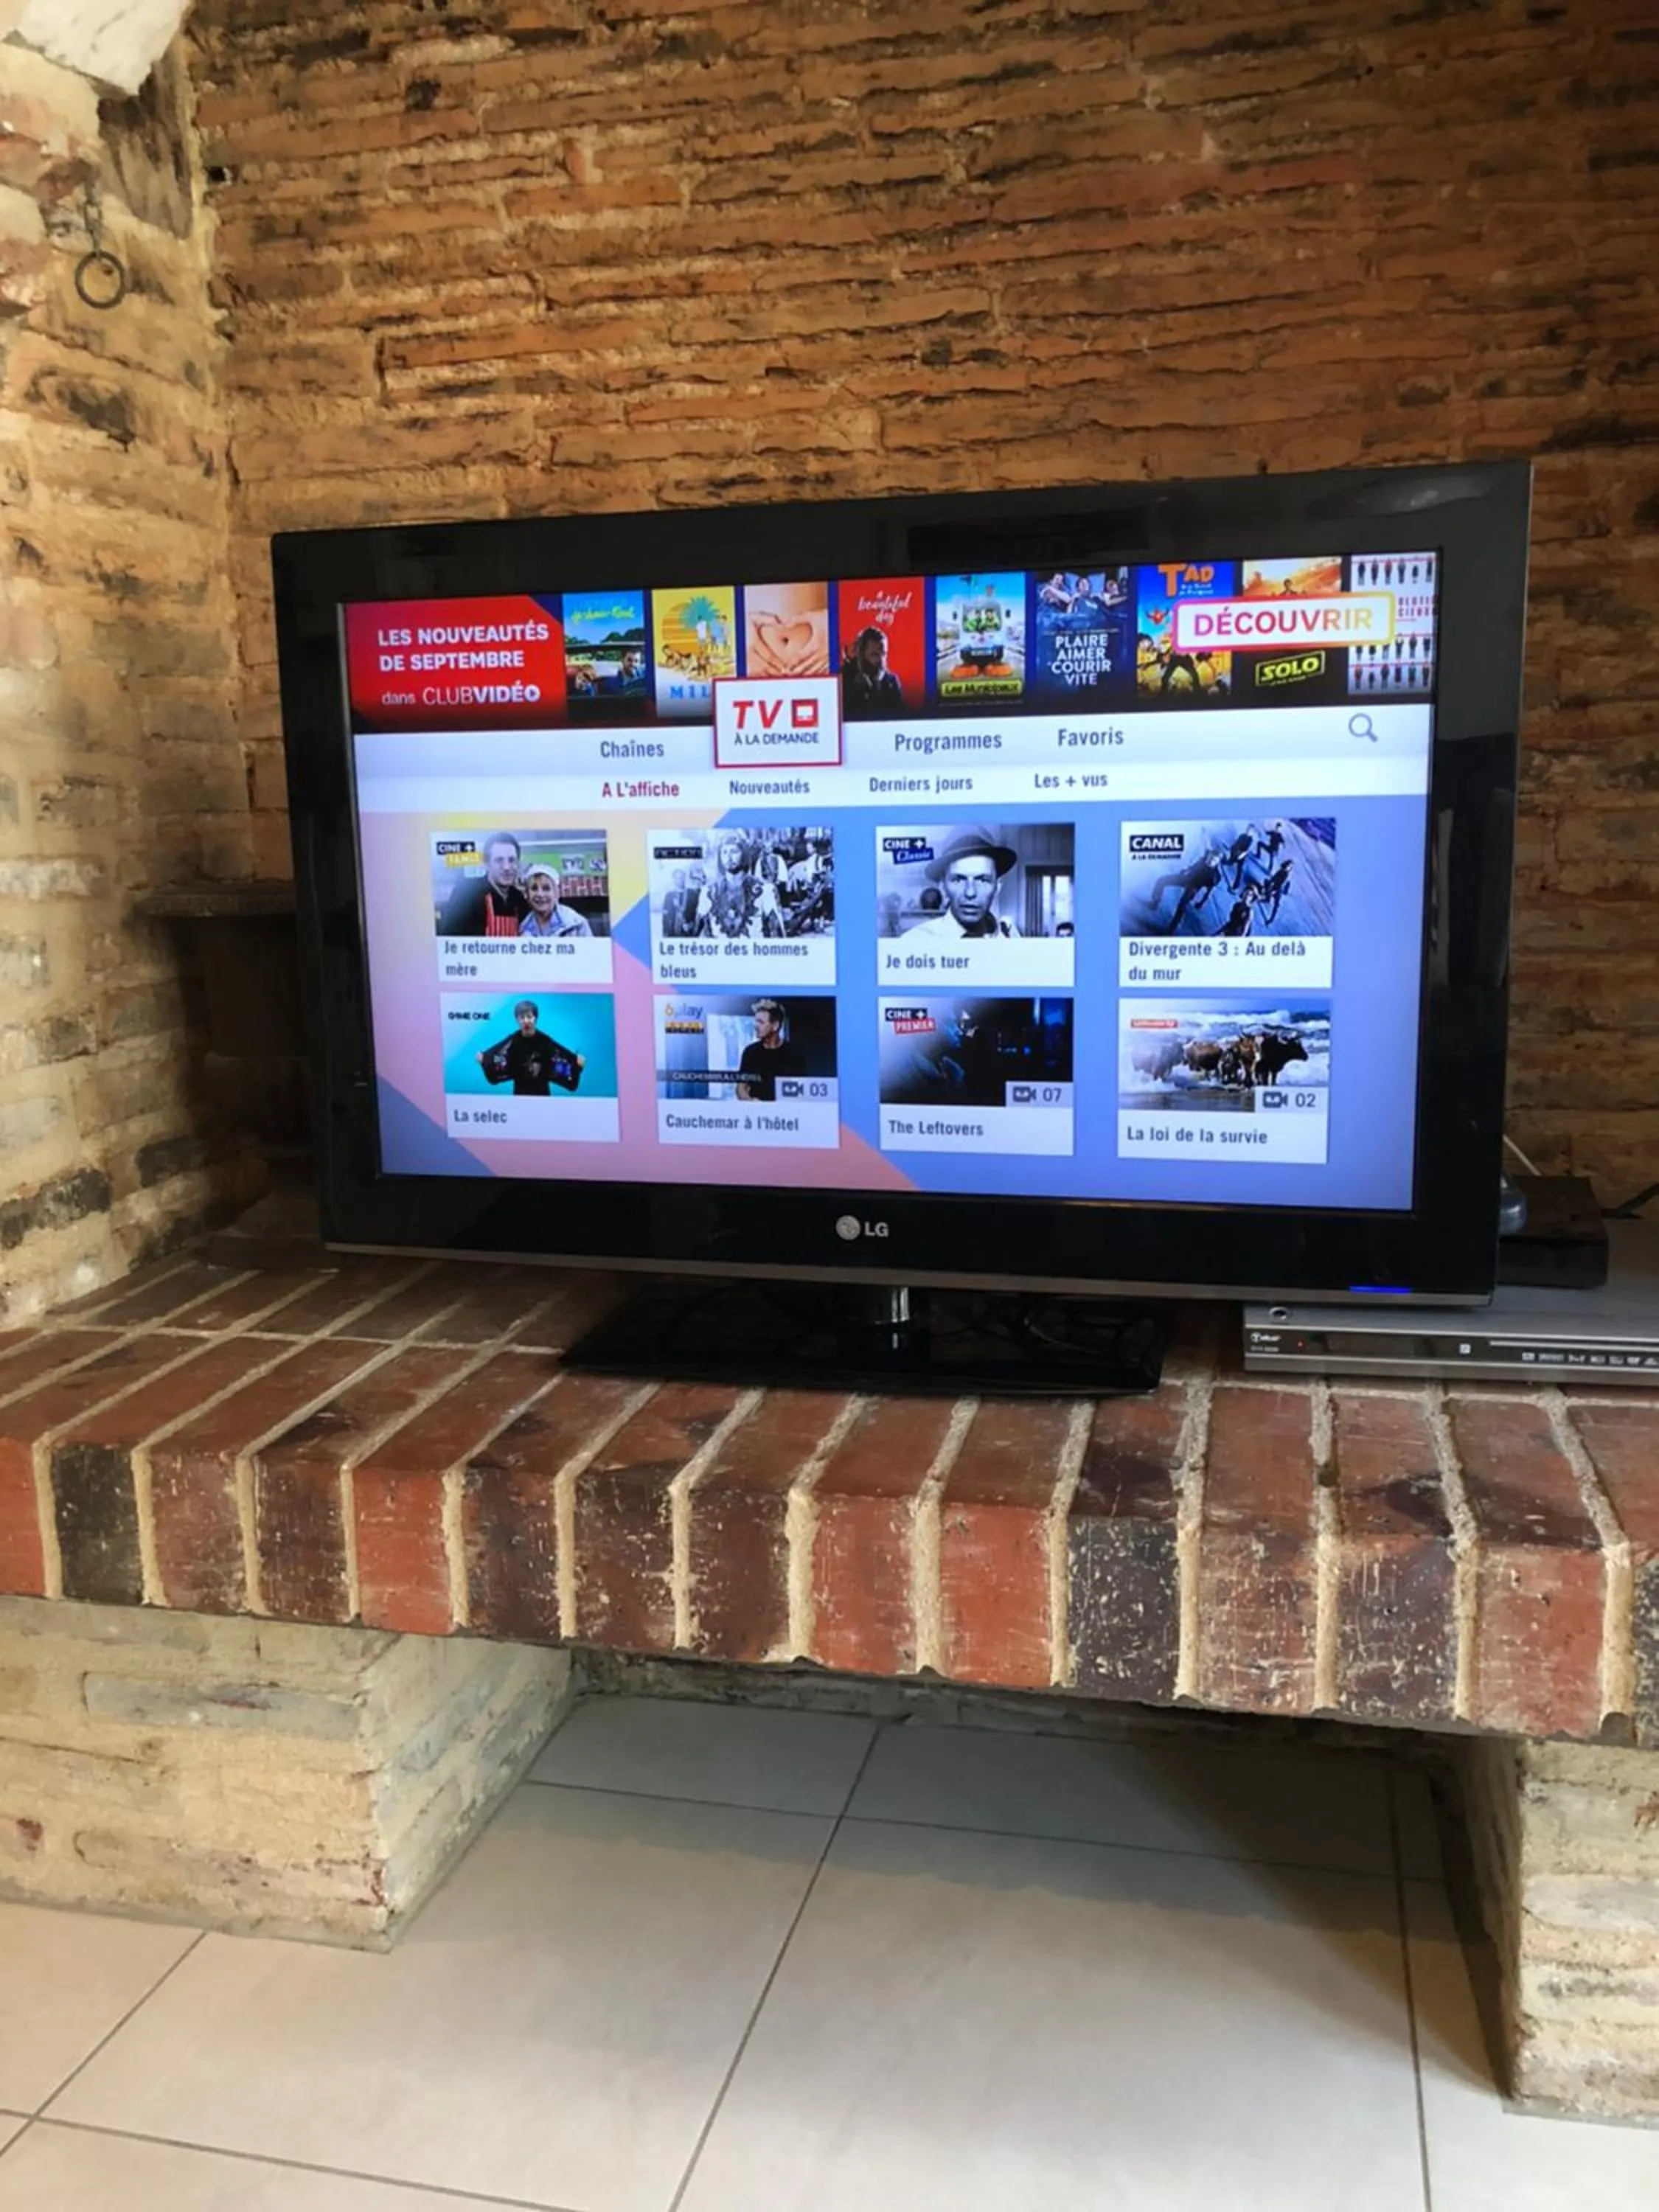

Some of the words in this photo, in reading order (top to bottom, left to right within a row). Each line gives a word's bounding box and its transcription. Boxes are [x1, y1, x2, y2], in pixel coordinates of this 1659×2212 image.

[1158, 563, 1215, 597] TAD
[1193, 606, 1372, 636] DÉCOUVRIR
[378, 628, 411, 646] LES
[417, 619, 549, 645] NOUVEAUTÉS
[1055, 633, 1108, 649] PLAIRE
[379, 655, 405, 672] DE
[410, 650, 525, 671] SEPTEMBRE
[1057, 647, 1106, 661] AIMER
[1051, 659, 1111, 675] COURIR
[1261, 657, 1319, 682] SOLO
[1065, 672, 1098, 686] VITE
[382, 687, 415, 706] dans
[732, 700, 783, 729] TV
[745, 734, 761, 745] LA
[763, 731, 819, 745] DEMANDE
[1057, 726, 1124, 746] Favoris
[600, 740, 664, 759] Chaînes
[894, 733, 1003, 756] Programmes
[729, 778, 810, 796] Nouveautés
[869, 776, 931, 793] Derniers
[935, 776, 973, 796] jours
[1034, 772, 1060, 788] Les
[1082, 773, 1108, 788] vus
[602, 782, 612, 798] A
[616, 780, 680, 798] L'affiche
[1132, 837, 1182, 849] CANAL
[444, 940, 457, 955] Je
[462, 940, 516, 955] retourne
[521, 941, 552, 955] chez
[557, 944, 575, 955] ma
[659, 942, 674, 956] Le
[679, 942, 719, 956] trésor
[724, 942, 748, 956] des
[753, 942, 808, 956] hommes
[1128, 942, 1212, 959] Divergente
[1217, 942, 1228, 956] 3
[1245, 942, 1265, 956] Au
[1271, 941, 1306, 956] delà
[445, 962, 478, 976] mère
[886, 955, 900, 969] Je
[906, 954, 936, 969] dois
[941, 955, 970, 969] tuer
[660, 964, 697, 979] bleus
[1128, 966, 1147, 981] du
[1152, 967, 1182, 981] mur
[810, 1082, 829, 1097] 03
[1043, 1088, 1062, 1102] 07
[1295, 1093, 1317, 1107] 02
[453, 1109, 469, 1122] La
[473, 1110, 508, 1123] selec
[666, 1114, 740, 1130] Cauchemar
[744, 1116, 753, 1130] à
[757, 1116, 799, 1131] l'hôtel
[888, 1119, 914, 1134] The
[919, 1120, 984, 1136] Leftovers
[1127, 1126, 1144, 1141] La
[1150, 1126, 1169, 1141] loi
[1175, 1127, 1194, 1142] de
[1200, 1127, 1214, 1143] la
[1220, 1128, 1268, 1144] survie
[864, 1221, 889, 1237] LG
